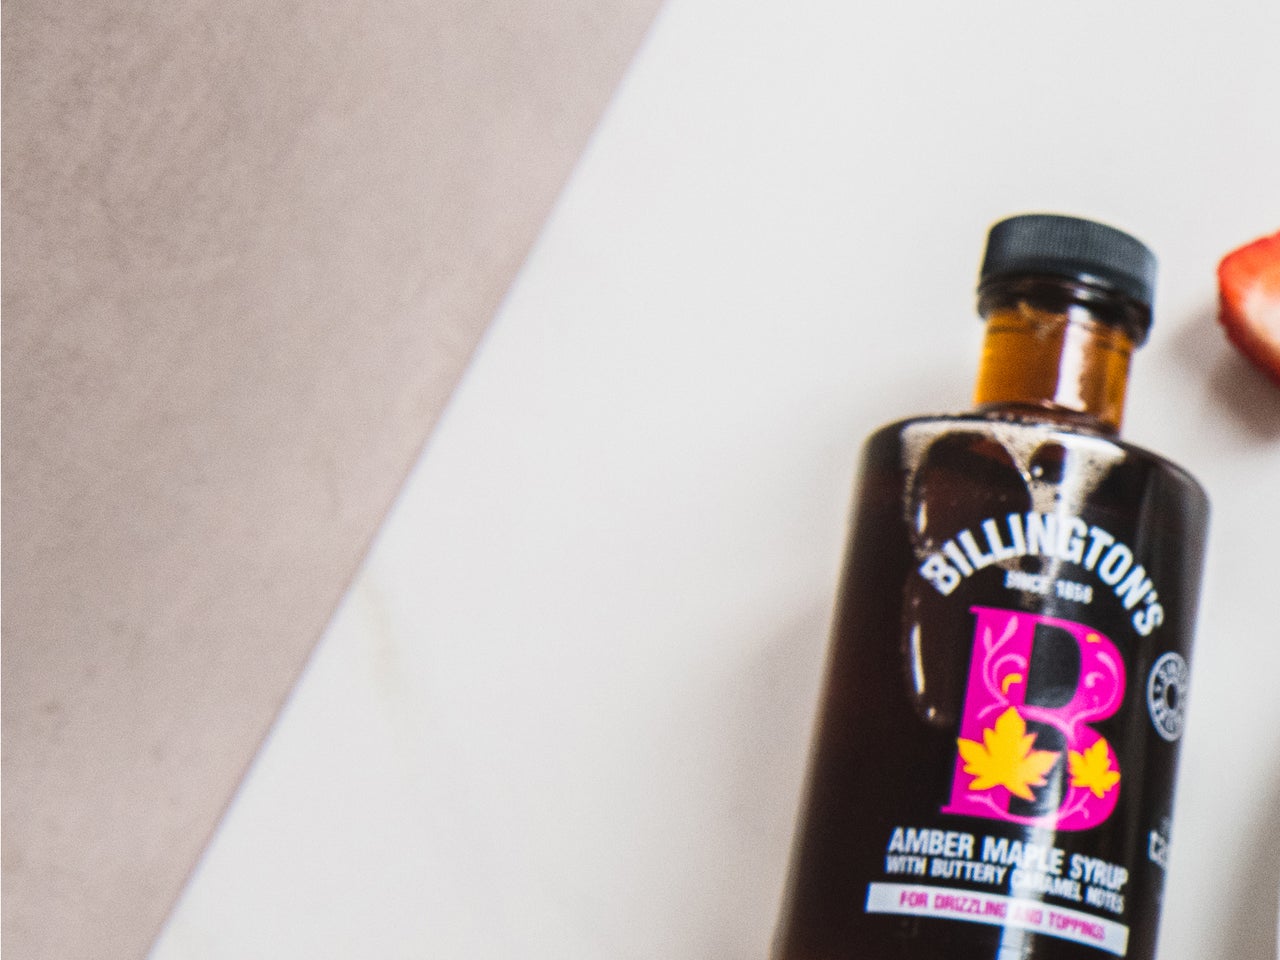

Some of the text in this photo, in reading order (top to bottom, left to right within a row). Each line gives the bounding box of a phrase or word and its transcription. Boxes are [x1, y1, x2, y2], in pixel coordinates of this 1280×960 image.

[919, 511, 1164, 637] BILLINGTON'S
[1005, 570, 1051, 595] SINCE
[941, 605, 1126, 832] B
[886, 855, 926, 875] WITH
[931, 857, 1007, 885] BUTTERY
[1085, 884, 1125, 914] NOTES
[888, 826, 1128, 891] AMBER MAPLE SYRUP
[900, 890, 928, 908] FOR
[933, 893, 1007, 919] DRIZZLING
[1049, 911, 1106, 941] TOPPINGS
